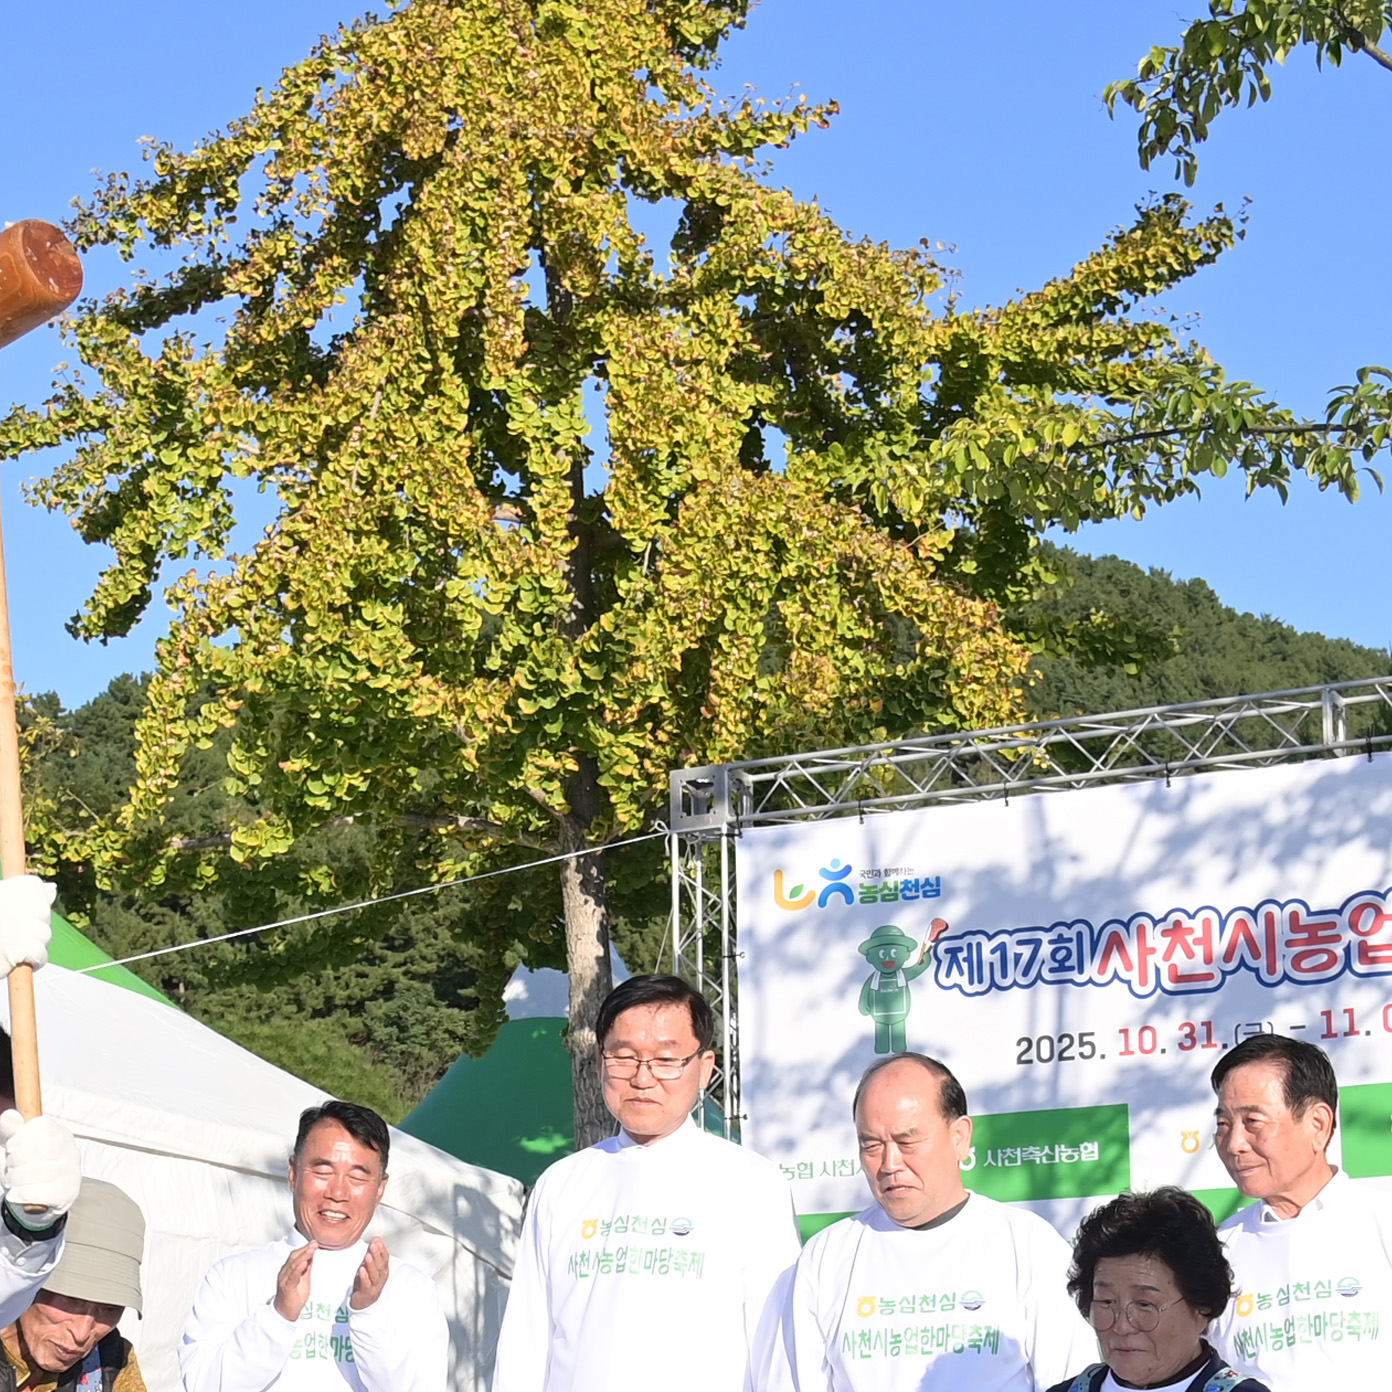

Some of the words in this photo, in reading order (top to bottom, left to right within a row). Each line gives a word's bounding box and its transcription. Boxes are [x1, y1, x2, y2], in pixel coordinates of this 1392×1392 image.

[858, 876, 941, 905] 농심천심
[943, 929, 1086, 988] 제17회
[1016, 1031, 1106, 1065] 2025.
[1118, 1025, 1167, 1056] 10.
[1320, 1008, 1371, 1039] 11.
[819, 1158, 862, 1178] 사천
[983, 1140, 1100, 1168] 사천축산농협
[600, 1214, 668, 1237] 농심천심
[567, 1245, 705, 1280] 사천시농업한마당축제
[878, 1292, 957, 1316] 농심천심
[1256, 1279, 1332, 1311] 농심천심
[842, 1323, 1000, 1360] 사천시농업한마당축제
[1233, 1311, 1381, 1362] 사천시농업한마당축제
